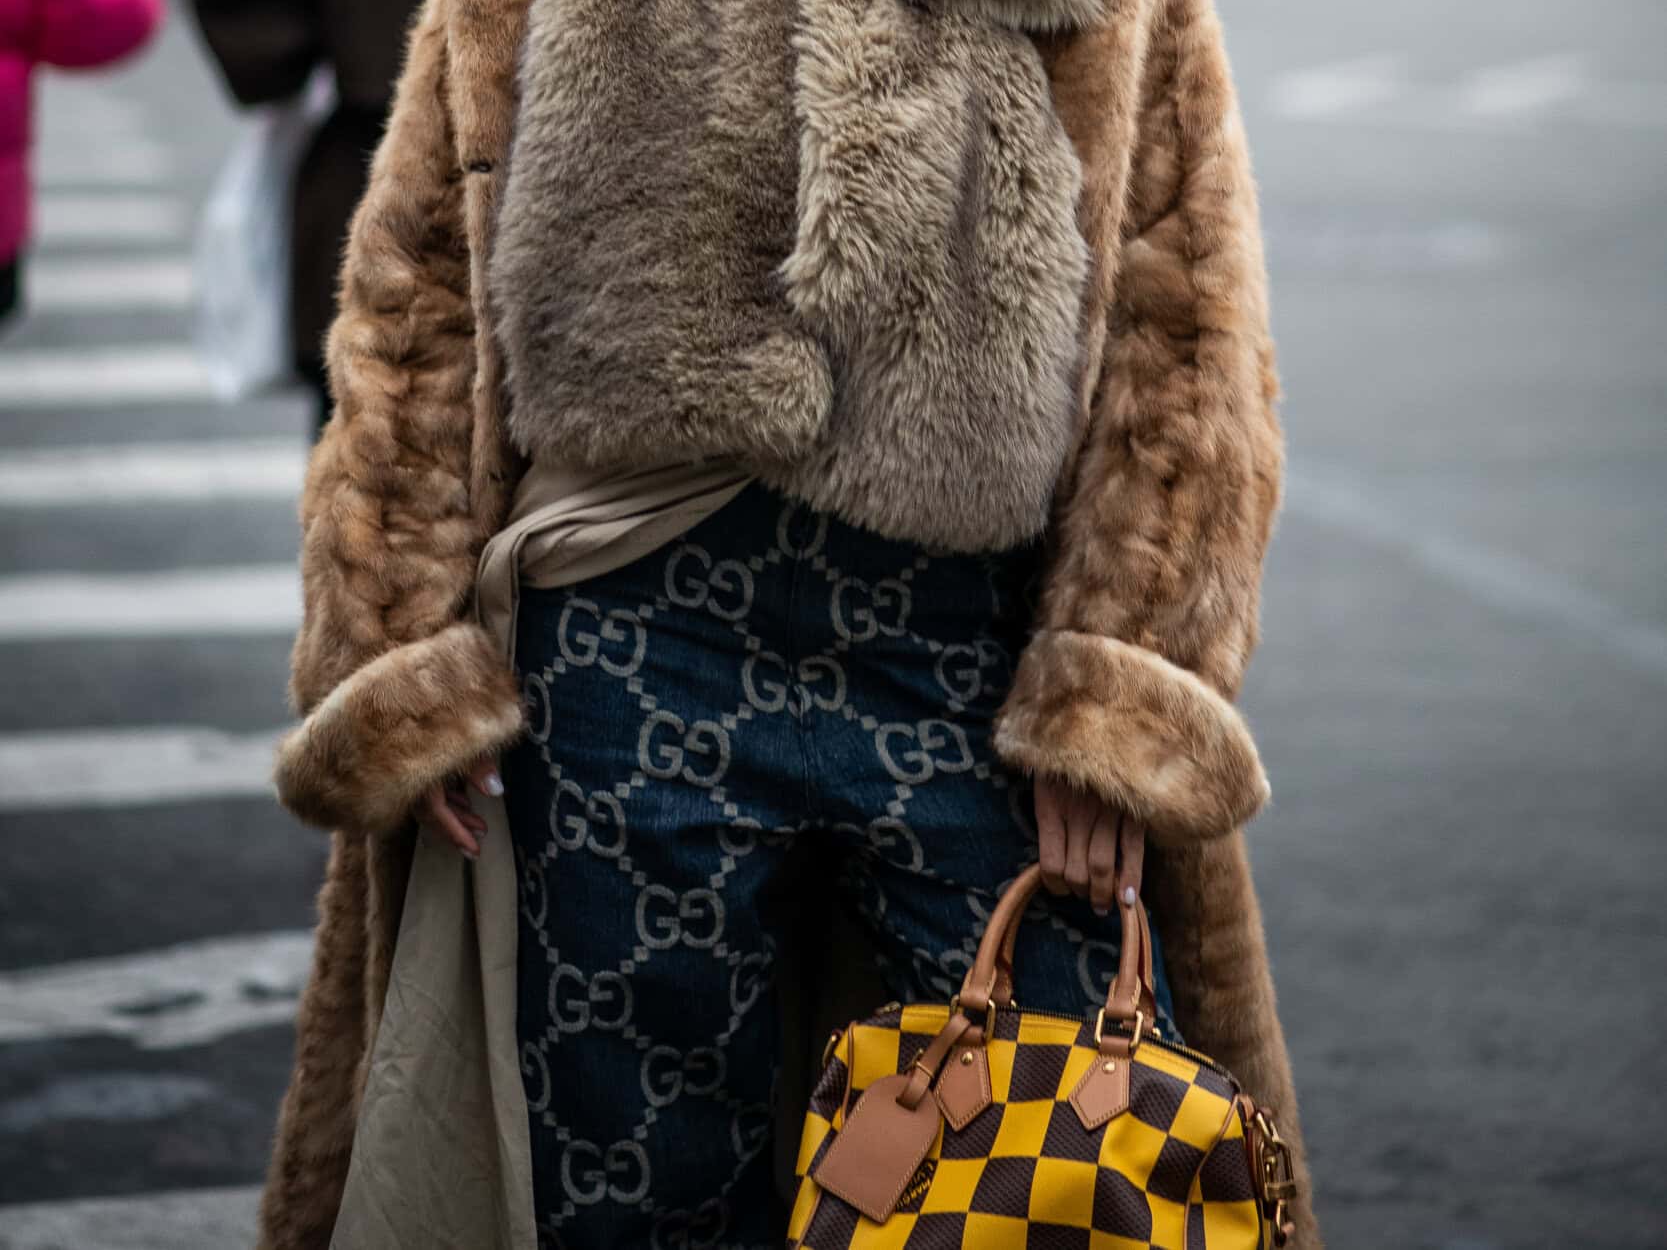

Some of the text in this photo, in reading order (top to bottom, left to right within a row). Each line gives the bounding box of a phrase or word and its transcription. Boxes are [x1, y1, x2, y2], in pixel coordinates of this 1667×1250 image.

[664, 543, 754, 621] GG
[557, 598, 647, 678] GG
[637, 708, 731, 788] GG
[874, 718, 975, 784] GG
[550, 778, 628, 858] GG
[635, 883, 725, 950] GG
[547, 962, 633, 1034] GG
[560, 1139, 651, 1206] GG
